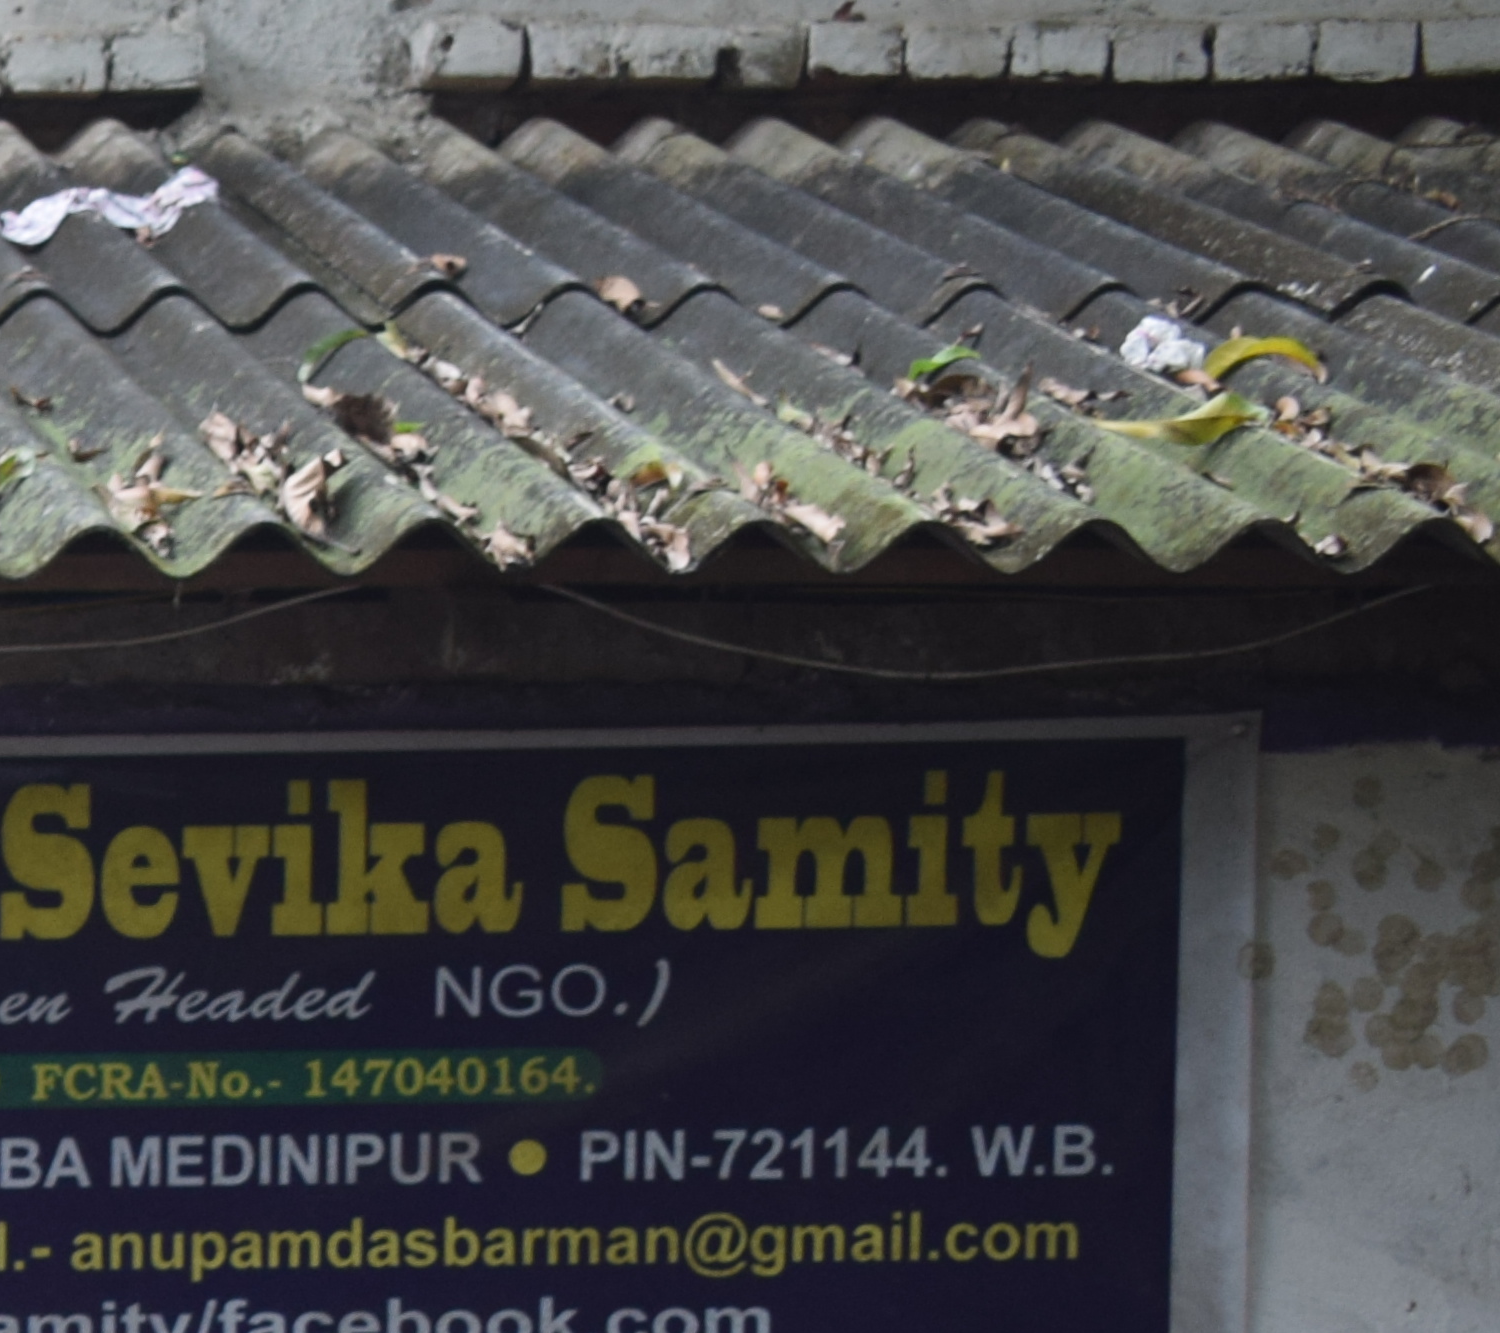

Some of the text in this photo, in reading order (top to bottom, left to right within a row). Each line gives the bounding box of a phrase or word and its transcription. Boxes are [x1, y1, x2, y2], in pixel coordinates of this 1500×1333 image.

[0, 780, 522, 941] Sevika
[562, 770, 1121, 958] Samity
[103, 966, 376, 1026] Headed
[435, 960, 670, 1026] NGO.)
[305, 1056, 596, 1099] 147040164.
[110, 1132, 484, 1187] MEDINIPUR
[580, 1127, 947, 1181] PIN-721144.
[972, 1125, 1113, 1177] W.B.
[70, 1211, 1079, 1282] anupamdasbarman@gmail.com
